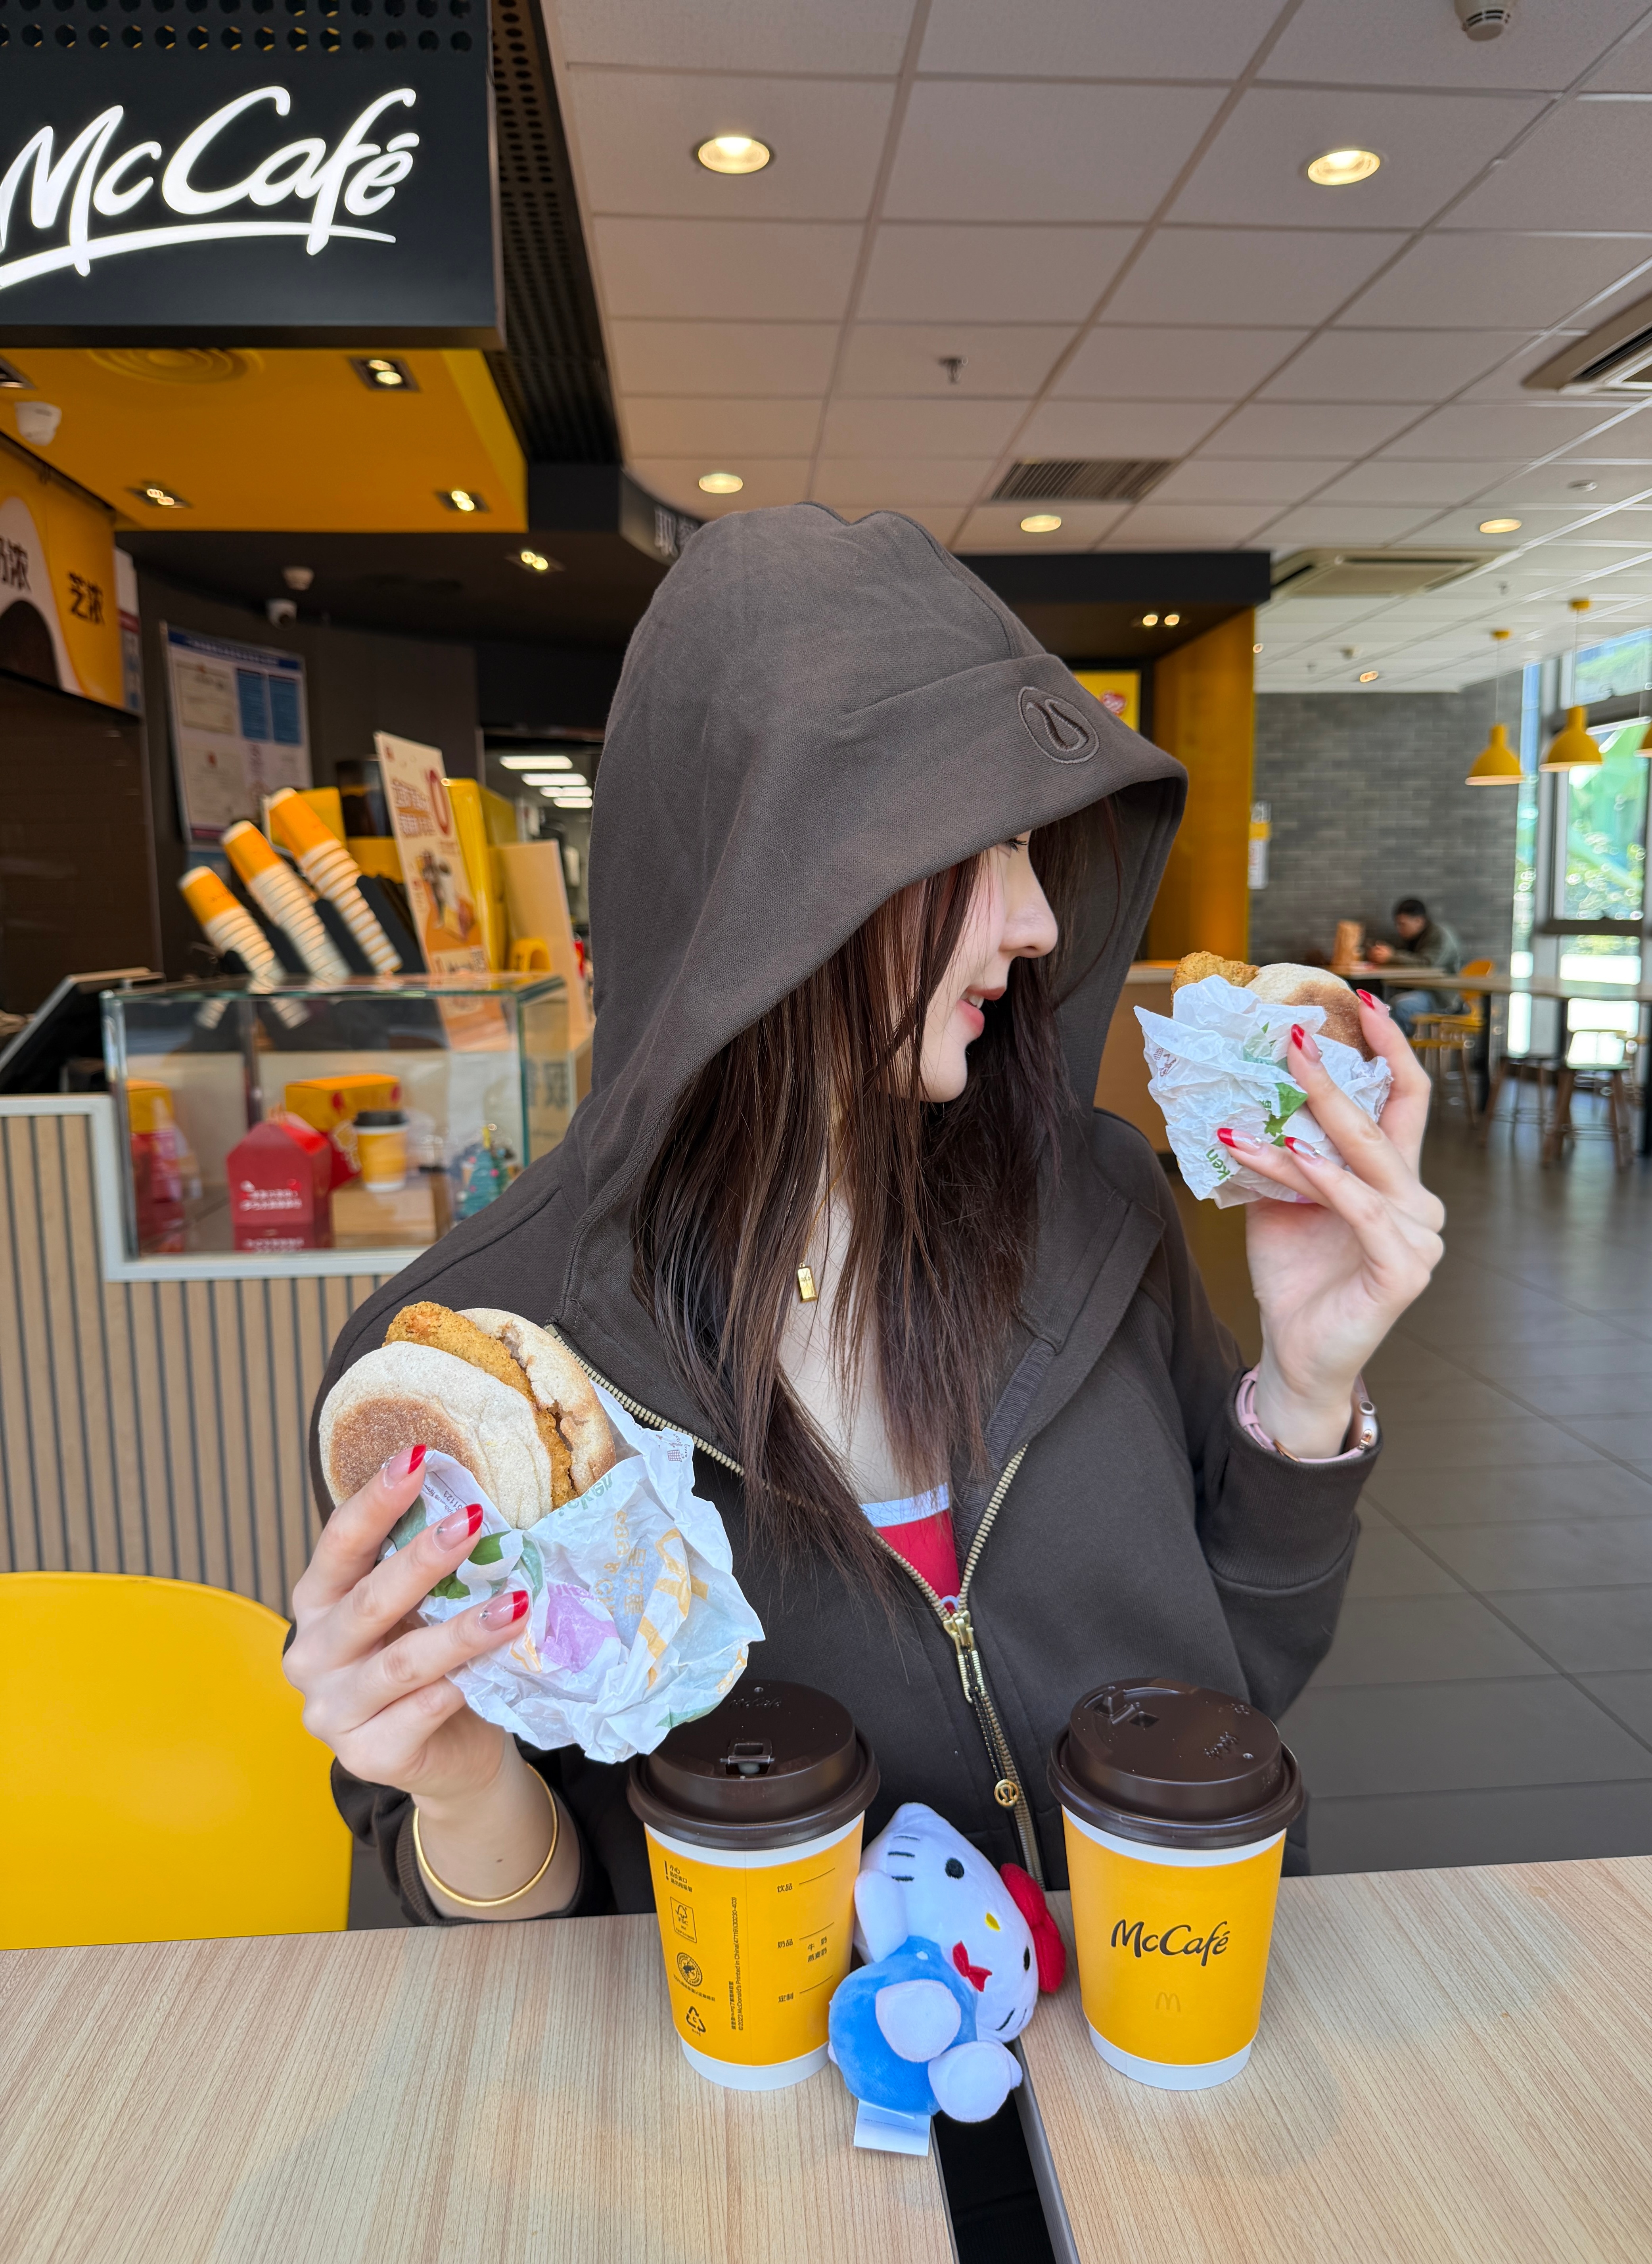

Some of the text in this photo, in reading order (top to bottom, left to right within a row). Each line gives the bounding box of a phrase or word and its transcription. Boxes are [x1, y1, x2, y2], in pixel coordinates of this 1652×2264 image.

[0, 86, 419, 277] McCafé
[1206, 1149, 1234, 1181] ken
[777, 1883, 793, 1893] 饮品
[777, 1938, 793, 1949] 奶品
[1111, 1919, 1230, 1967] McCafé
